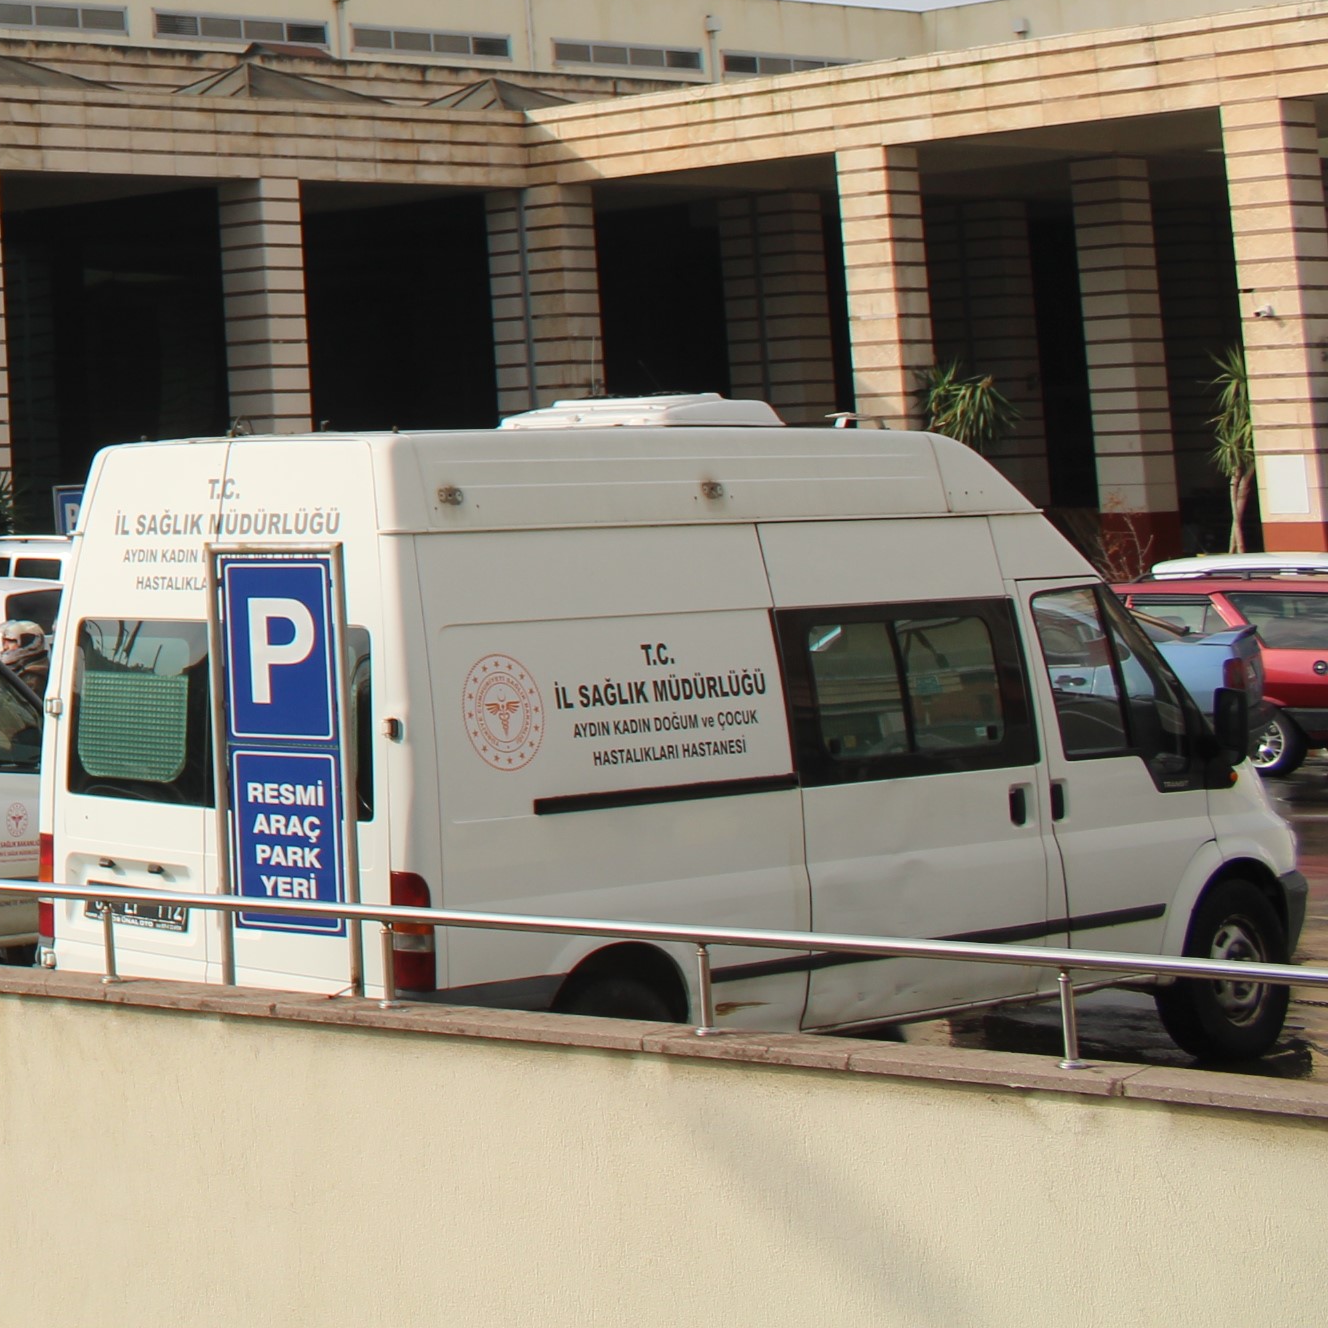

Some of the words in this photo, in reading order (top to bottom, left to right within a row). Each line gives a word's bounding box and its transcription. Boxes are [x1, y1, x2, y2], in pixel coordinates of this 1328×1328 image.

[208, 478, 240, 500] T.C.
[115, 510, 130, 535] İL
[135, 509, 204, 536] SAĞLIK
[208, 507, 340, 535] MÜDÜRLÜĞÜ
[123, 548, 159, 563] AYDIN
[161, 548, 198, 563] KADIN
[135, 576, 207, 591] HASTALIKLA
[247, 597, 315, 704] P
[640, 642, 675, 666] T.C.
[554, 680, 574, 709] İL
[578, 677, 649, 708] SAĞLIK
[652, 668, 767, 702] MÜDÜRLÜĞÜ
[573, 719, 612, 739] AYDIN
[613, 717, 652, 736] KADIN
[655, 712, 699, 732] DOĞUM
[701, 716, 715, 729] ve
[717, 709, 759, 732] ÇOCUK
[592, 744, 680, 767] HASTALIKLARI
[682, 735, 747, 758] HASTANESİ
[247, 779, 325, 807] RESMİ
[253, 813, 322, 843] ARAÇ
[255, 843, 322, 870] PARK
[260, 873, 317, 900] YERİ
